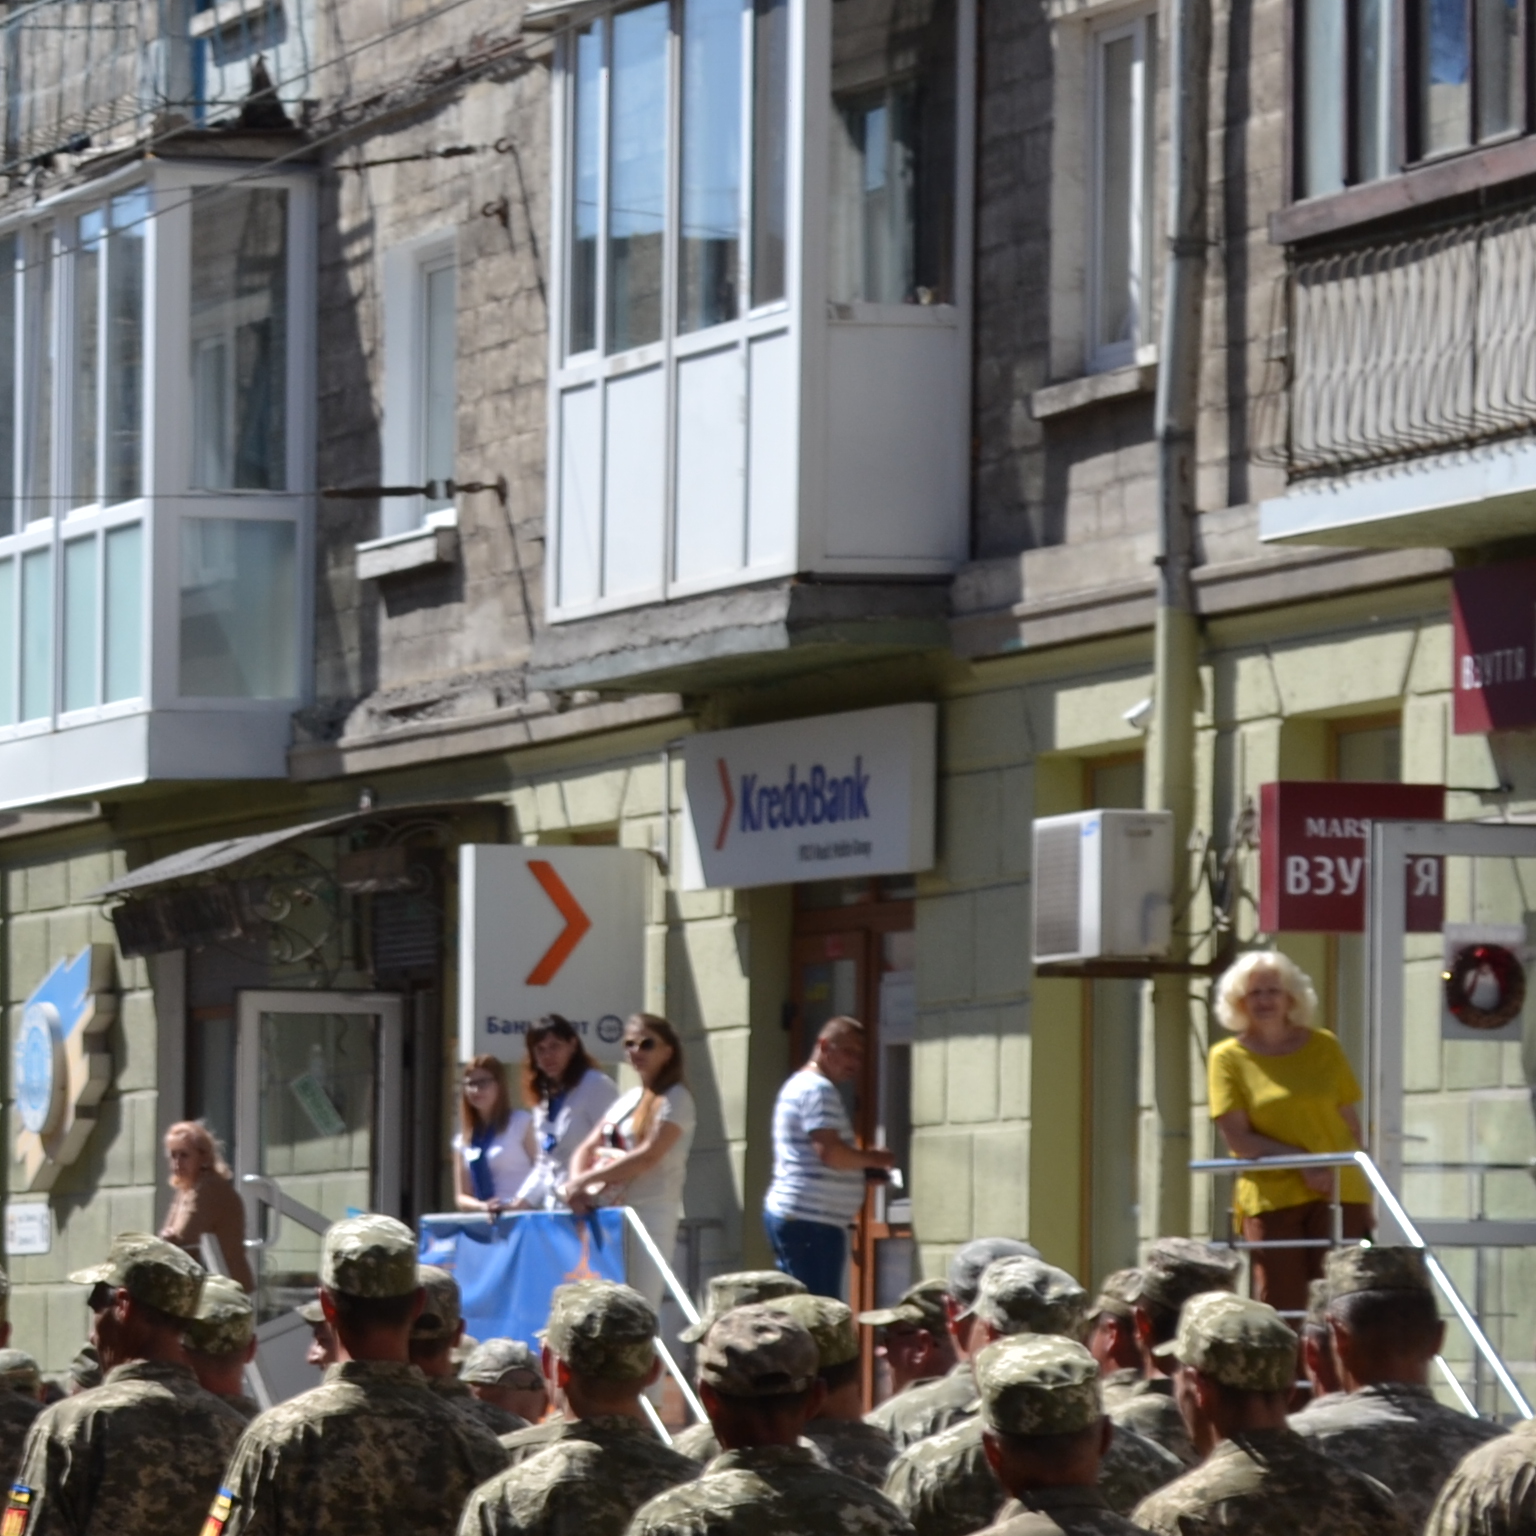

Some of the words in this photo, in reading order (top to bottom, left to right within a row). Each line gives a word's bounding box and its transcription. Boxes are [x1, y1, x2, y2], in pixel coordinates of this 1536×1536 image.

[1461, 647, 1526, 690] ВЗУТТЯ
[740, 755, 871, 833] KredoBank
[1305, 817, 1372, 838] MARS
[1285, 855, 1439, 896] ВЗУЯ
[486, 1015, 590, 1035] Бант
